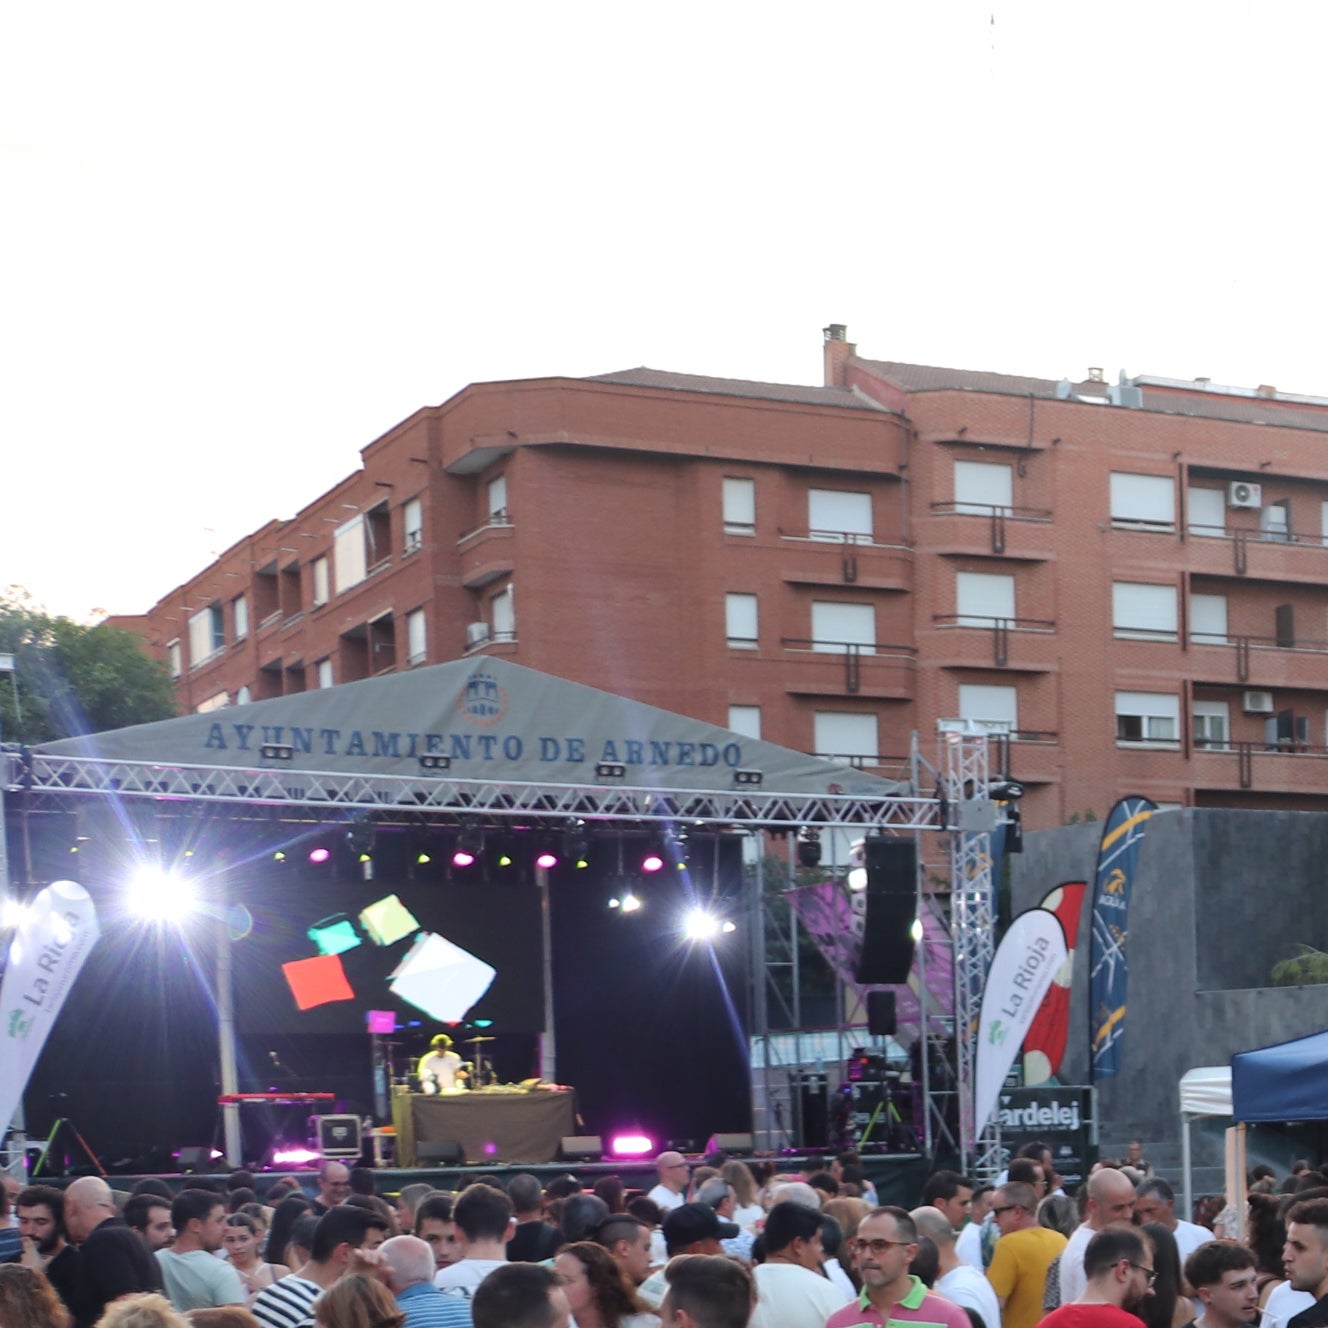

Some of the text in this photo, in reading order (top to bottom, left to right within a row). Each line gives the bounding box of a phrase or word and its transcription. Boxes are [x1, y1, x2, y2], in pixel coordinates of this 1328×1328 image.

[204, 721, 742, 769] AYUNTAMIENTO DE ARNEDO
[1001, 993, 1024, 1019] La
[1013, 936, 1050, 991] Rioja
